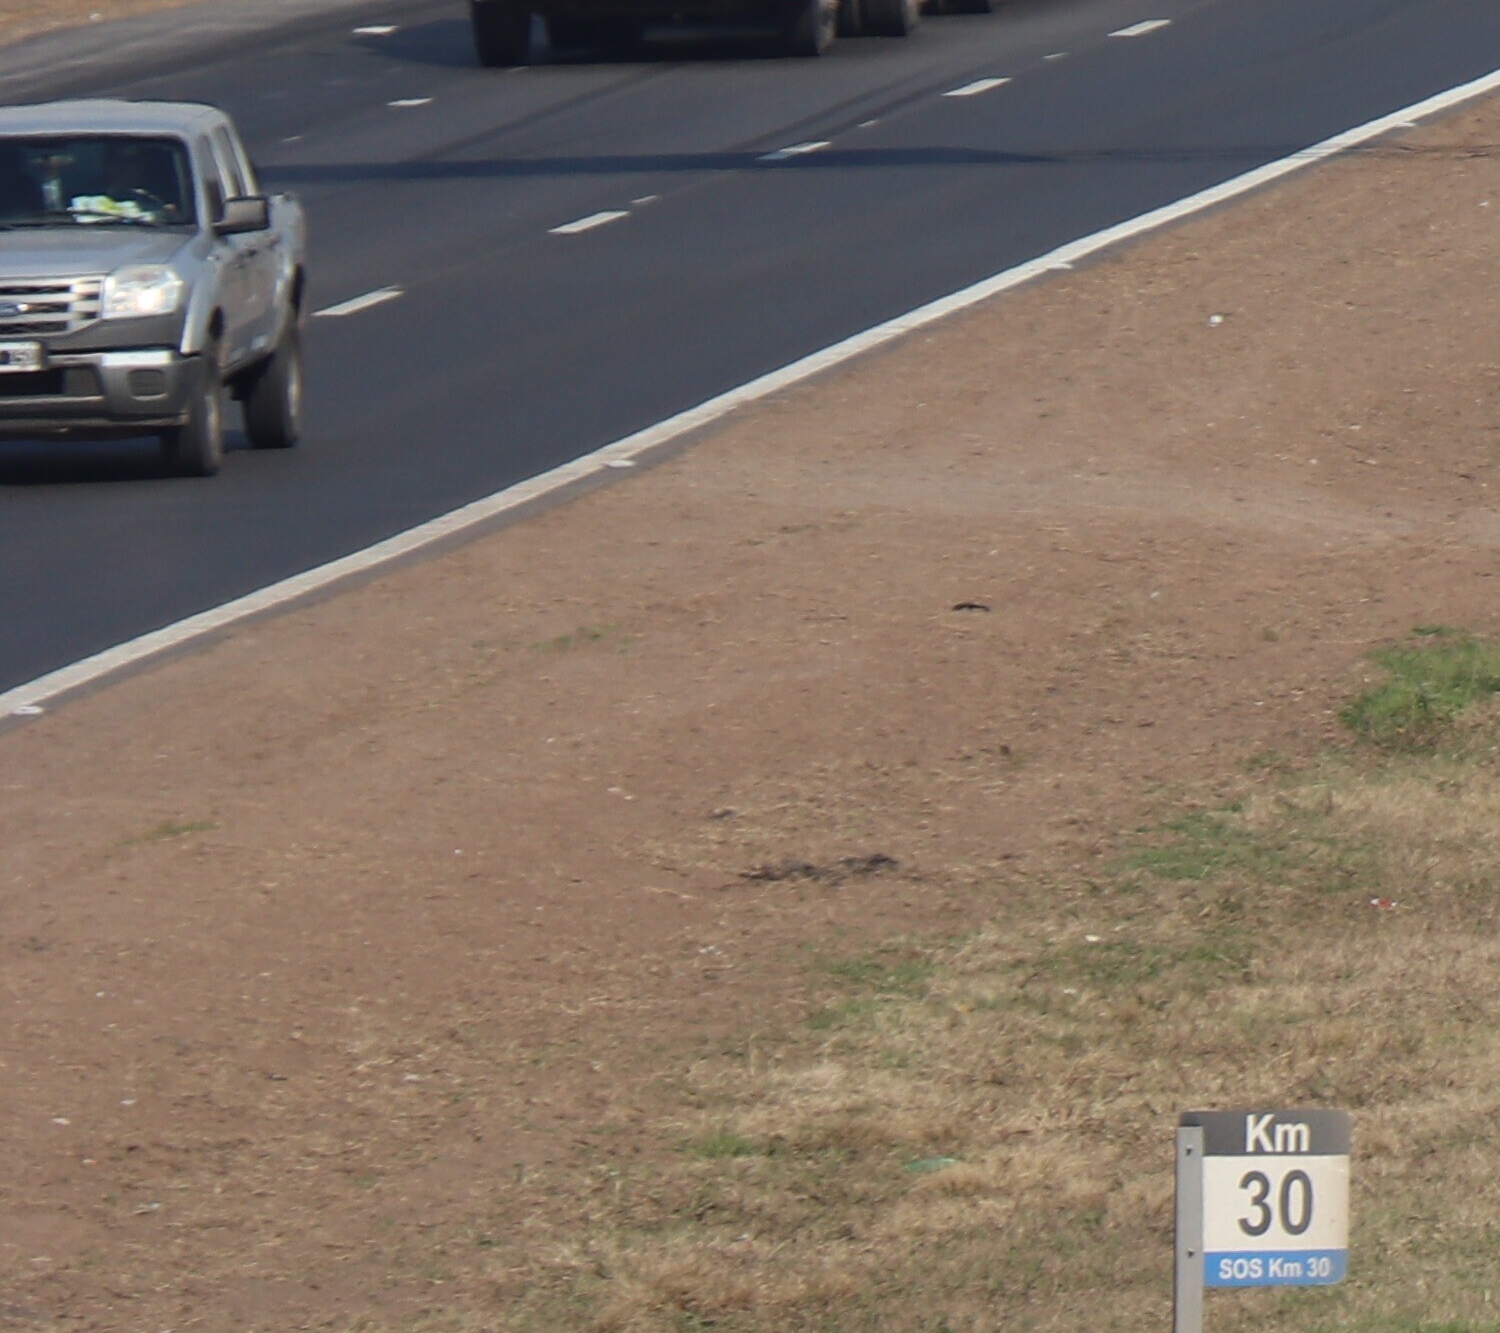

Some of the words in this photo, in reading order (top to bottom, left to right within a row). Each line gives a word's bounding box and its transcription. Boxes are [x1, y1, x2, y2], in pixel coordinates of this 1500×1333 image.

[1245, 1113, 1311, 1153] Km
[1237, 1168, 1313, 1237] 30
[1218, 1257, 1263, 1280] SOS
[1268, 1257, 1303, 1279] Km
[1306, 1256, 1331, 1278] 30
